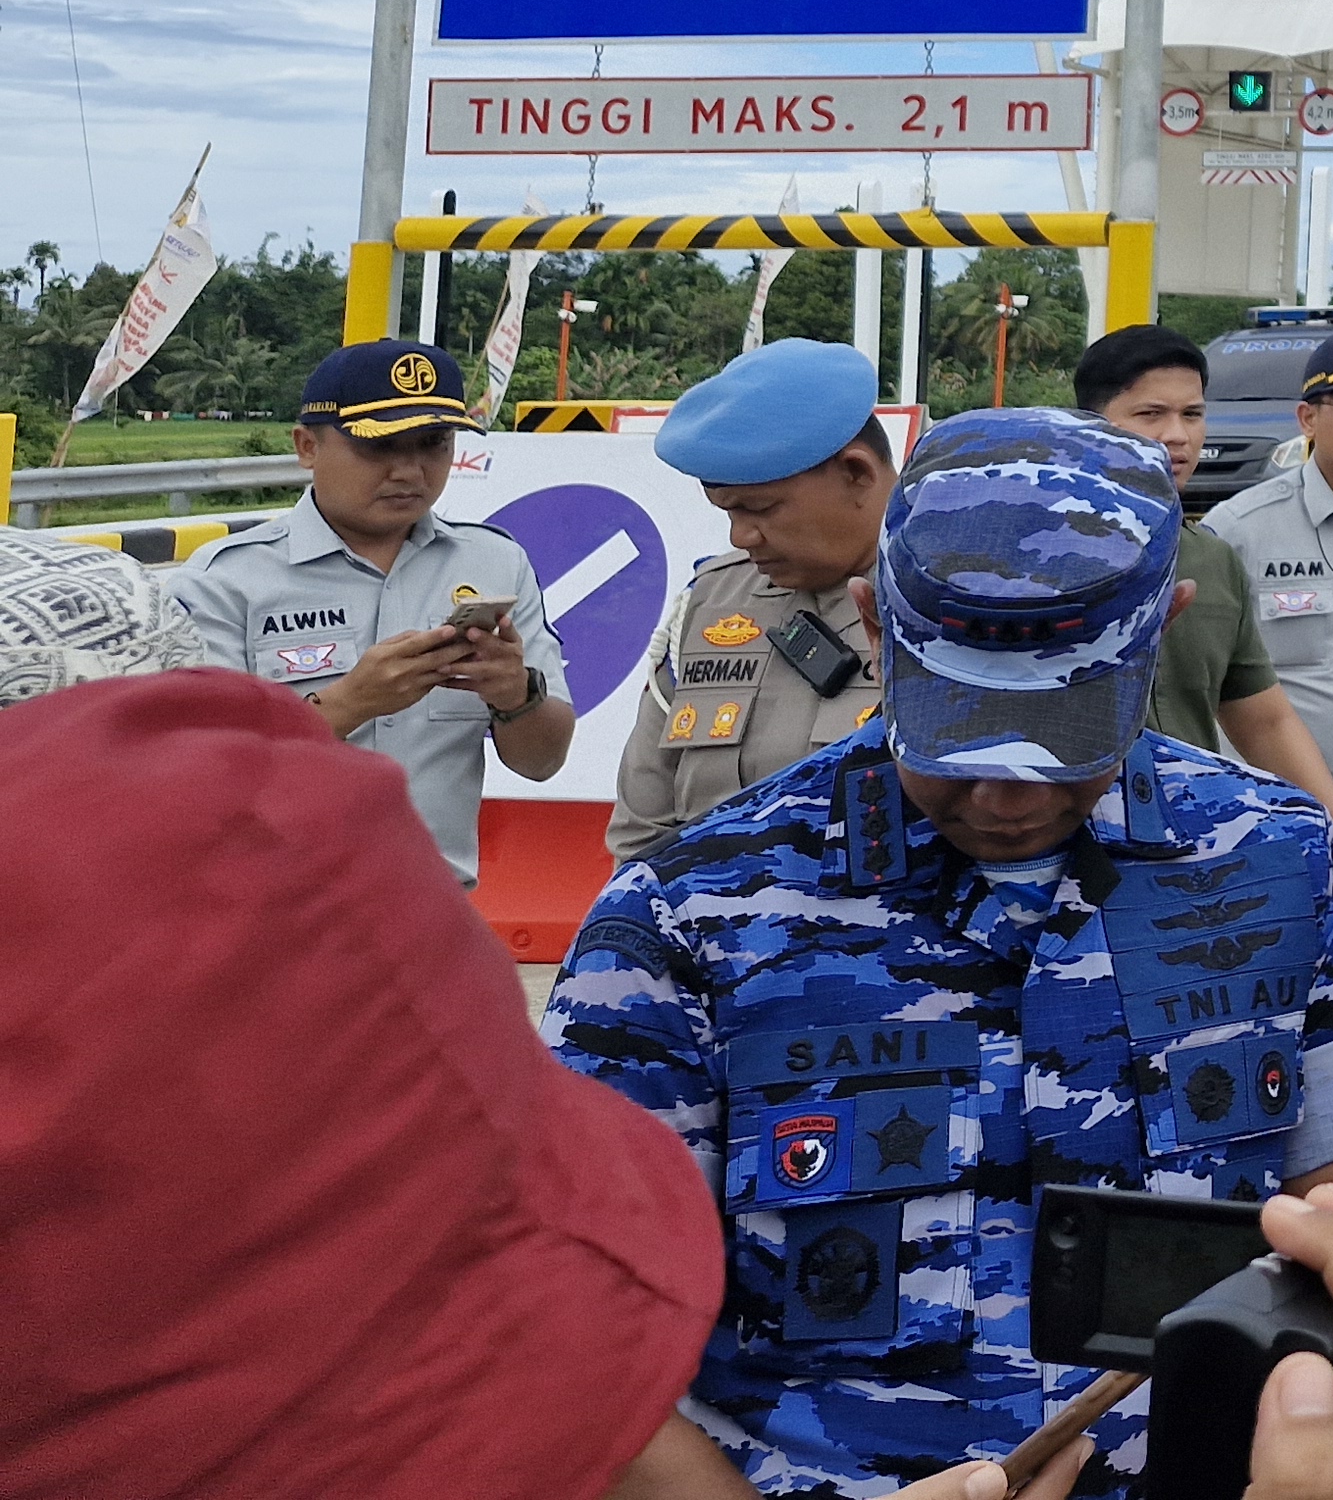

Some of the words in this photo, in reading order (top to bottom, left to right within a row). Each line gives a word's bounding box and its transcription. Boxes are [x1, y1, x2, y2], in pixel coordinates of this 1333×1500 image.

[469, 98, 651, 135] TINGGI
[691, 95, 855, 134] MAKS.
[901, 95, 969, 140] 2,1
[1007, 102, 1049, 131] m
[1222, 339, 1322, 355] PROP
[1265, 560, 1325, 578] ADAM
[262, 608, 346, 635] ALWIN
[682, 658, 759, 684] HERMAN
[1155, 985, 1233, 1024] TNI
[1251, 975, 1297, 1009] AU
[785, 1030, 929, 1072] SANI
